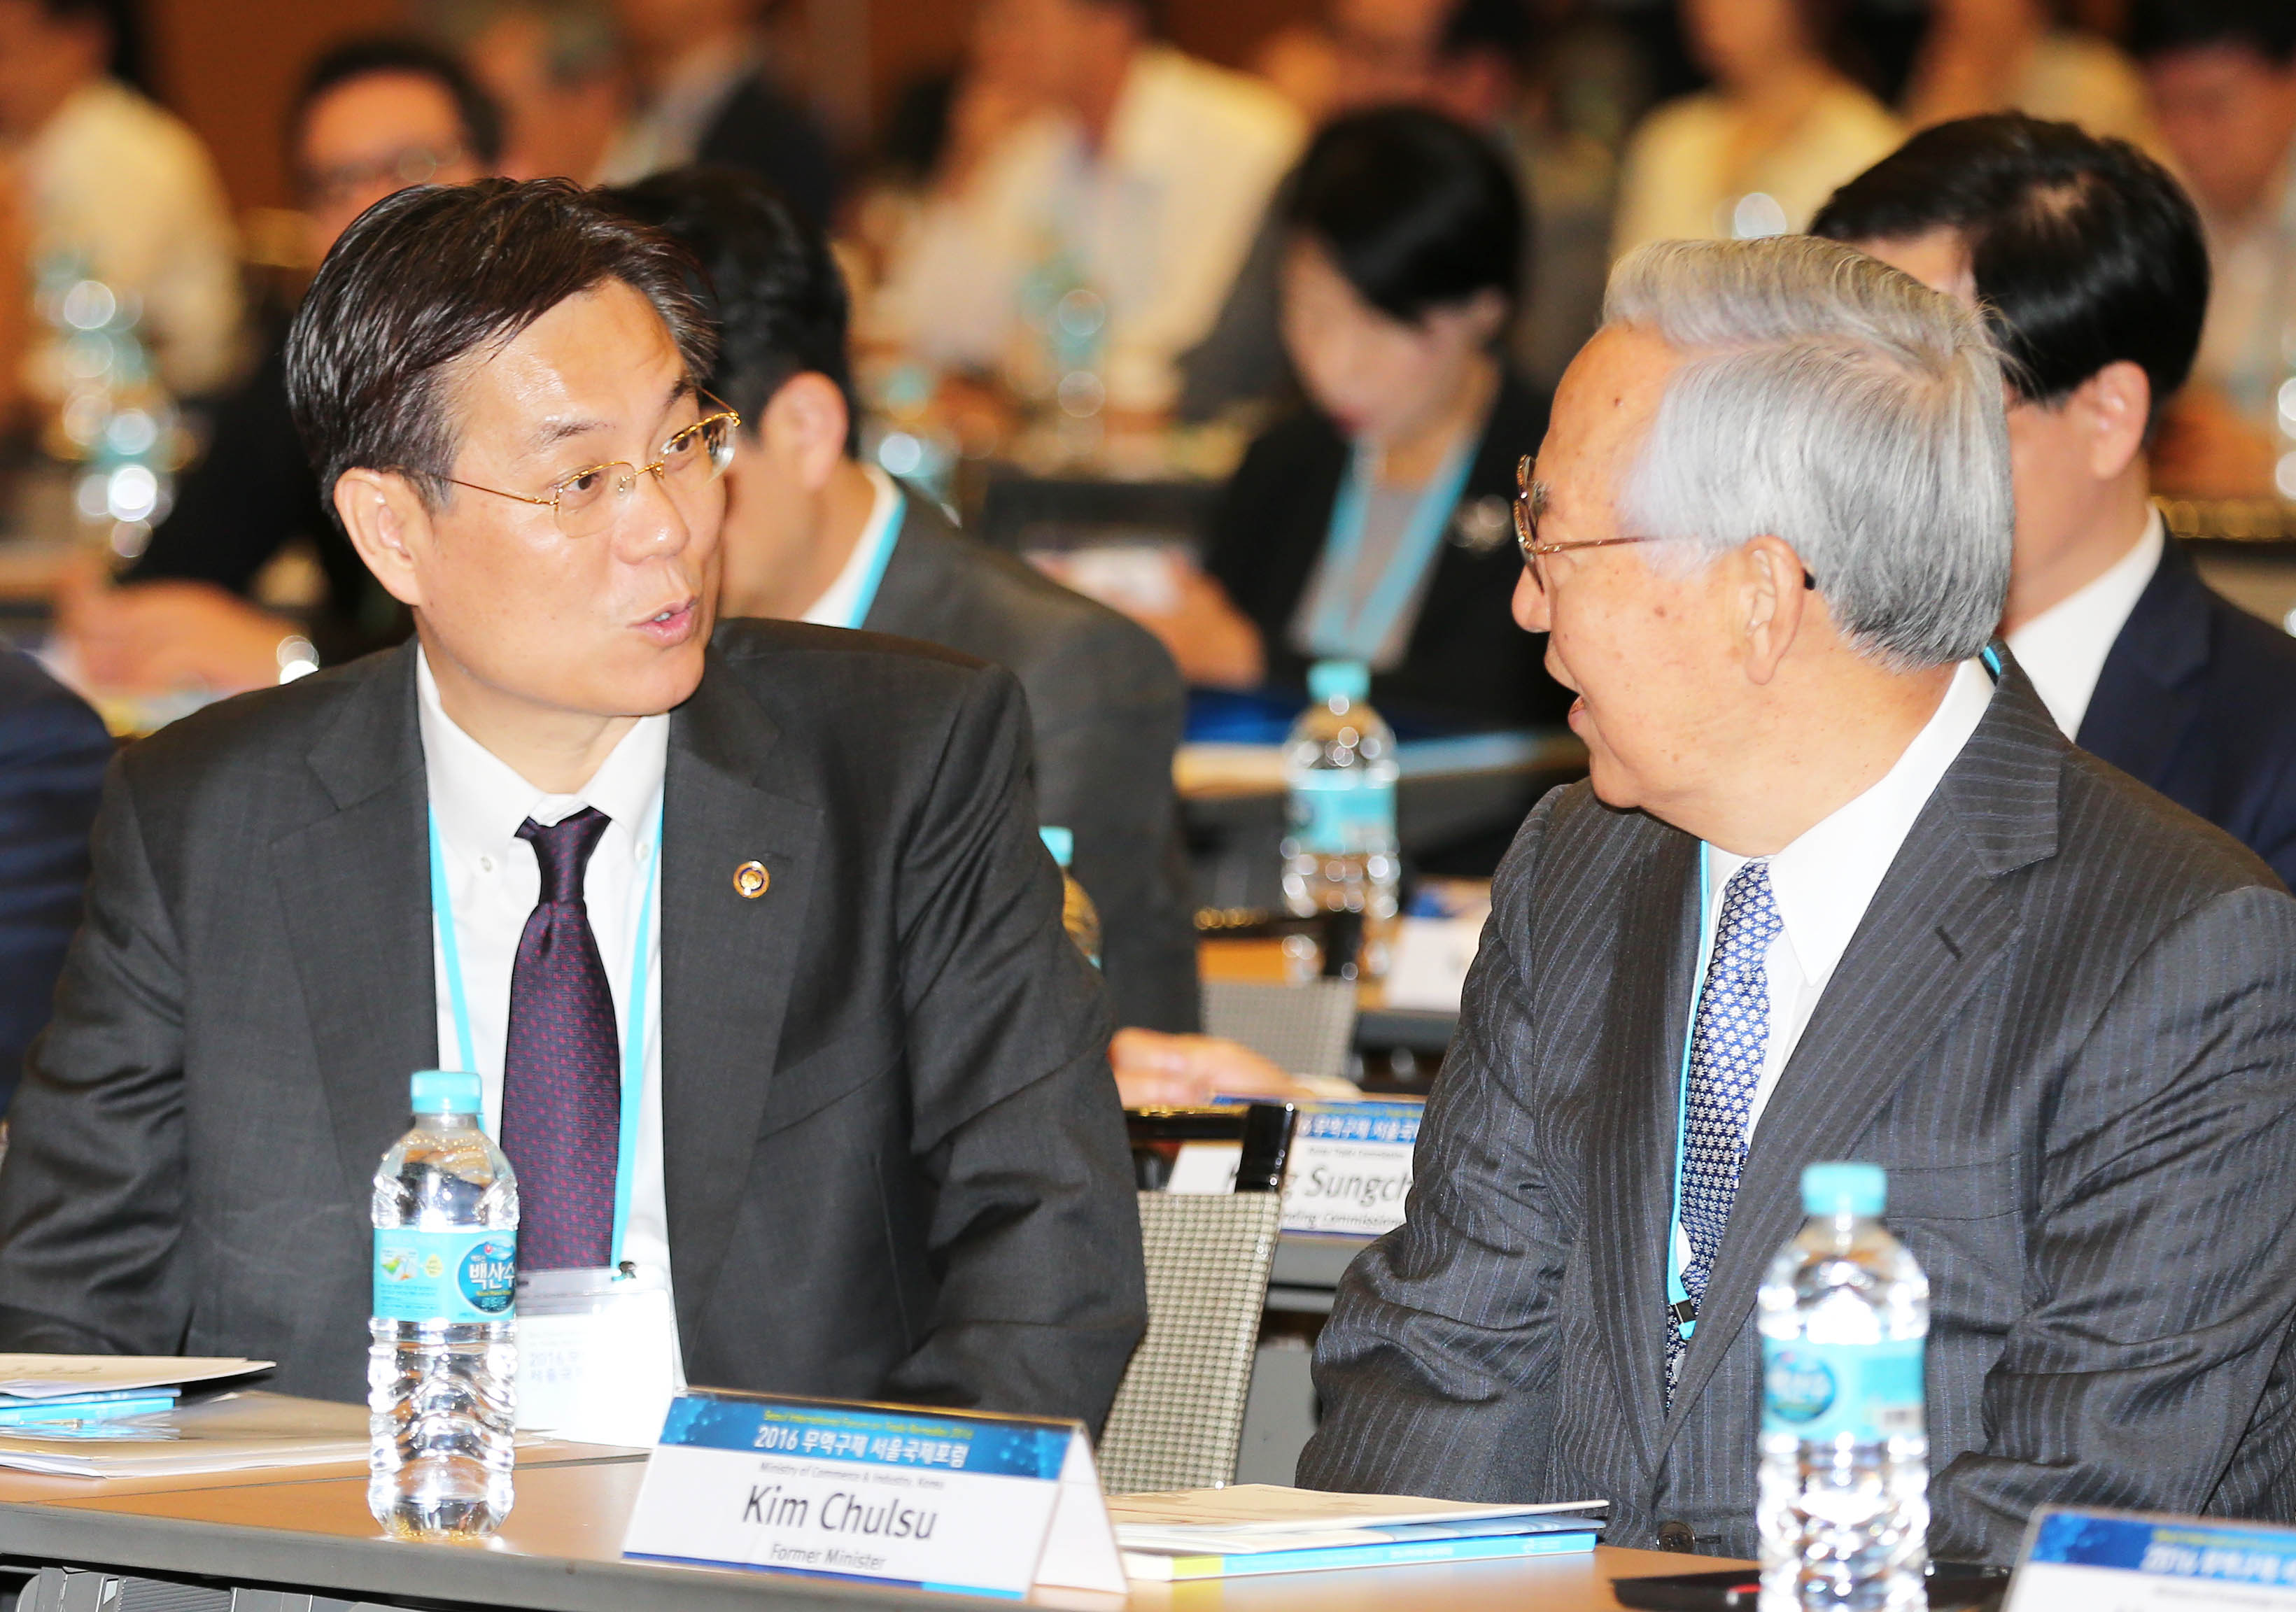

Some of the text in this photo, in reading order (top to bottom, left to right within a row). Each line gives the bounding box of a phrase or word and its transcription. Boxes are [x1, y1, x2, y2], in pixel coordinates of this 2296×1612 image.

[1304, 1164, 1414, 1207] Sungch
[470, 1261, 515, 1290] 백산수
[754, 1424, 970, 1469] 2016 무역구제 서울국제포럼
[742, 1483, 939, 1539] Kim Chulsu
[770, 1543, 887, 1571] Former Minister
